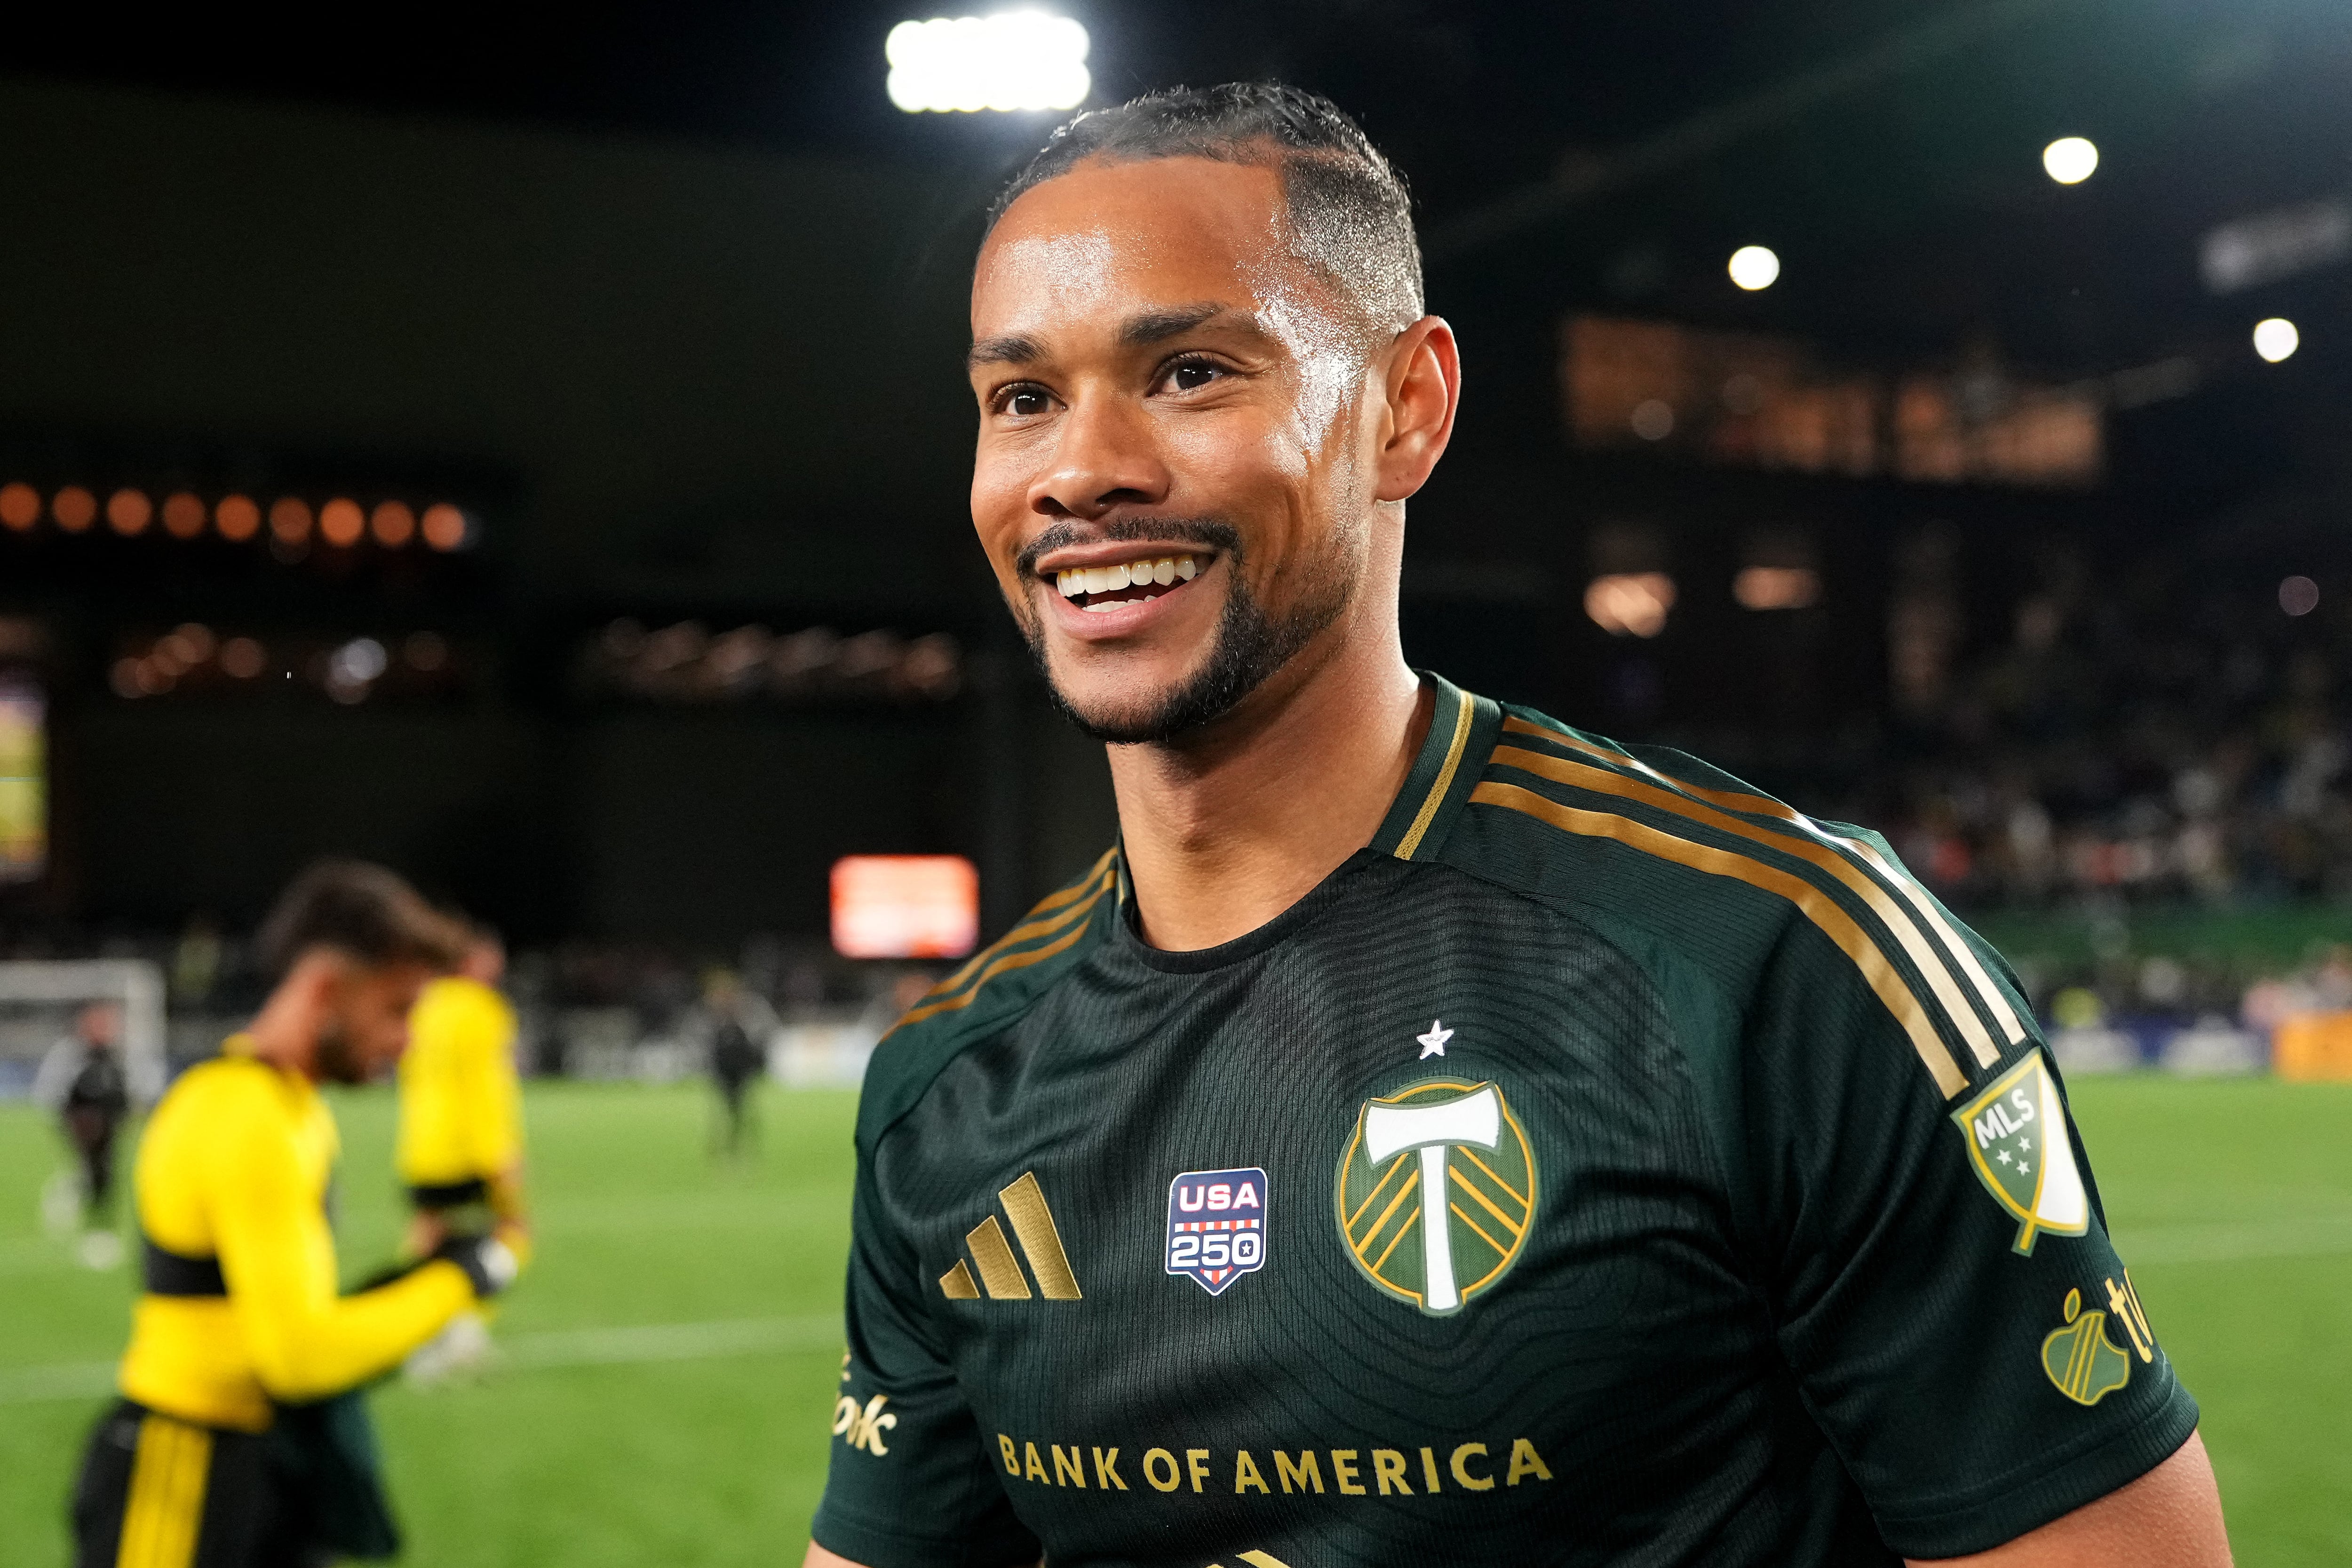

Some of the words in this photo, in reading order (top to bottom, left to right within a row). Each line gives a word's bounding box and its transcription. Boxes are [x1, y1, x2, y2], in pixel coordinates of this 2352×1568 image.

[1974, 1088, 2035, 1149] MLS
[1179, 1181, 1260, 1212] USA
[1171, 1232, 1261, 1267] 250
[998, 1433, 1128, 1490] BANK
[1143, 1448, 1210, 1493] OF
[1235, 1439, 1552, 1495] AMERICA
